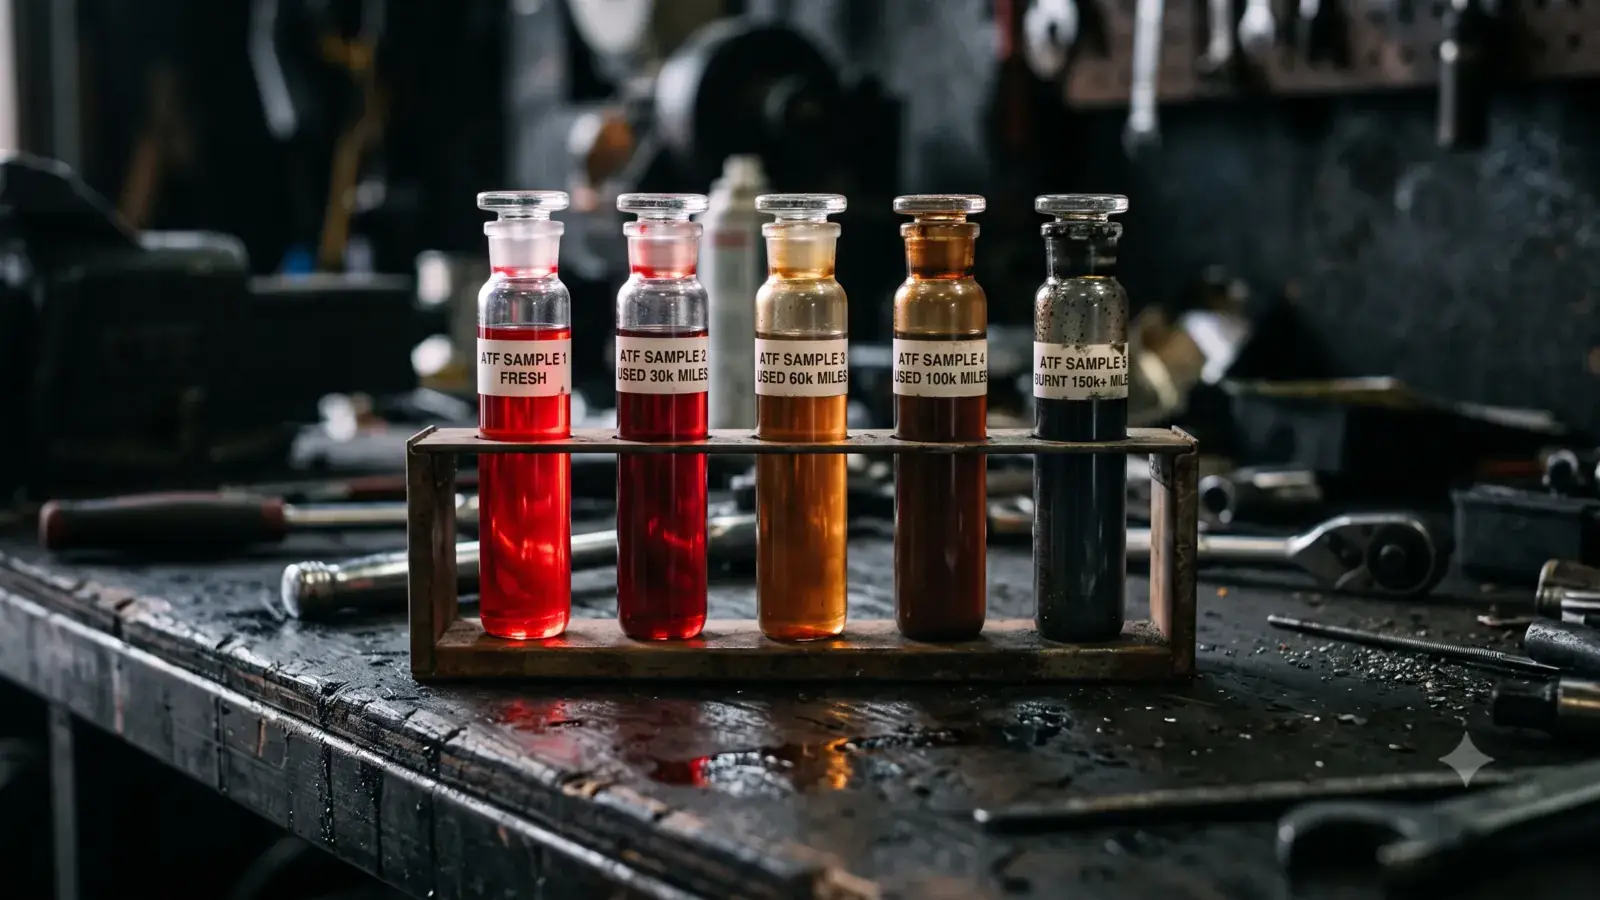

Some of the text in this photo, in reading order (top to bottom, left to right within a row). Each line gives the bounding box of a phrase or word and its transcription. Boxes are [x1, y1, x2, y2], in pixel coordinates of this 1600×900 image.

[481, 352, 500, 365] ATF
[504, 352, 559, 366] SAMPLE
[620, 349, 706, 363] ATF SAMPLE 2
[760, 352, 845, 366] ATF SAMPLE 3
[899, 352, 984, 366] ATF SAMPLE 4
[1040, 355, 1126, 370] ATF SAMPLE 5
[500, 372, 546, 384] FRESH
[618, 367, 708, 382] USED 30k MILES
[757, 370, 848, 384] USED 60k MILES
[895, 370, 921, 384] USED
[926, 372, 957, 385] 100k
[1035, 373, 1068, 387] BURNT
[1072, 375, 1107, 388] 150k+
